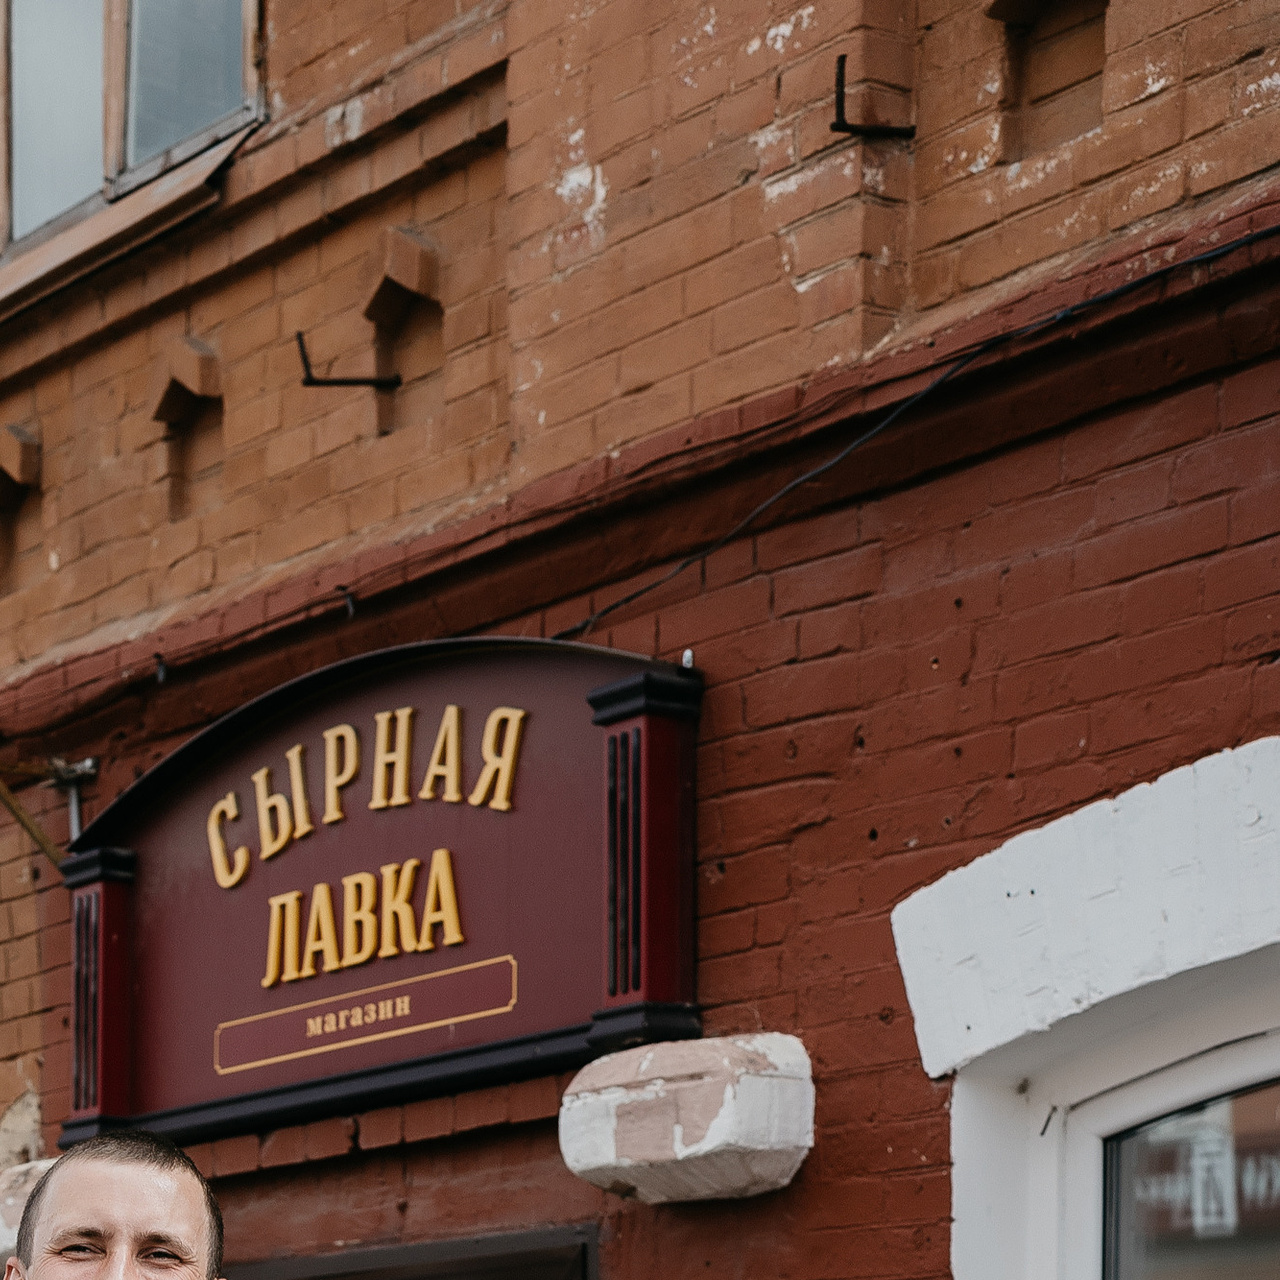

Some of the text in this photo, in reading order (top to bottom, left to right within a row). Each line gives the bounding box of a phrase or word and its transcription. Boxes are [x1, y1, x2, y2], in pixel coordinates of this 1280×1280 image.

[206, 704, 525, 889] СЫРНАЯ
[260, 848, 464, 989] ЛАВКА
[306, 995, 411, 1038] магазин
